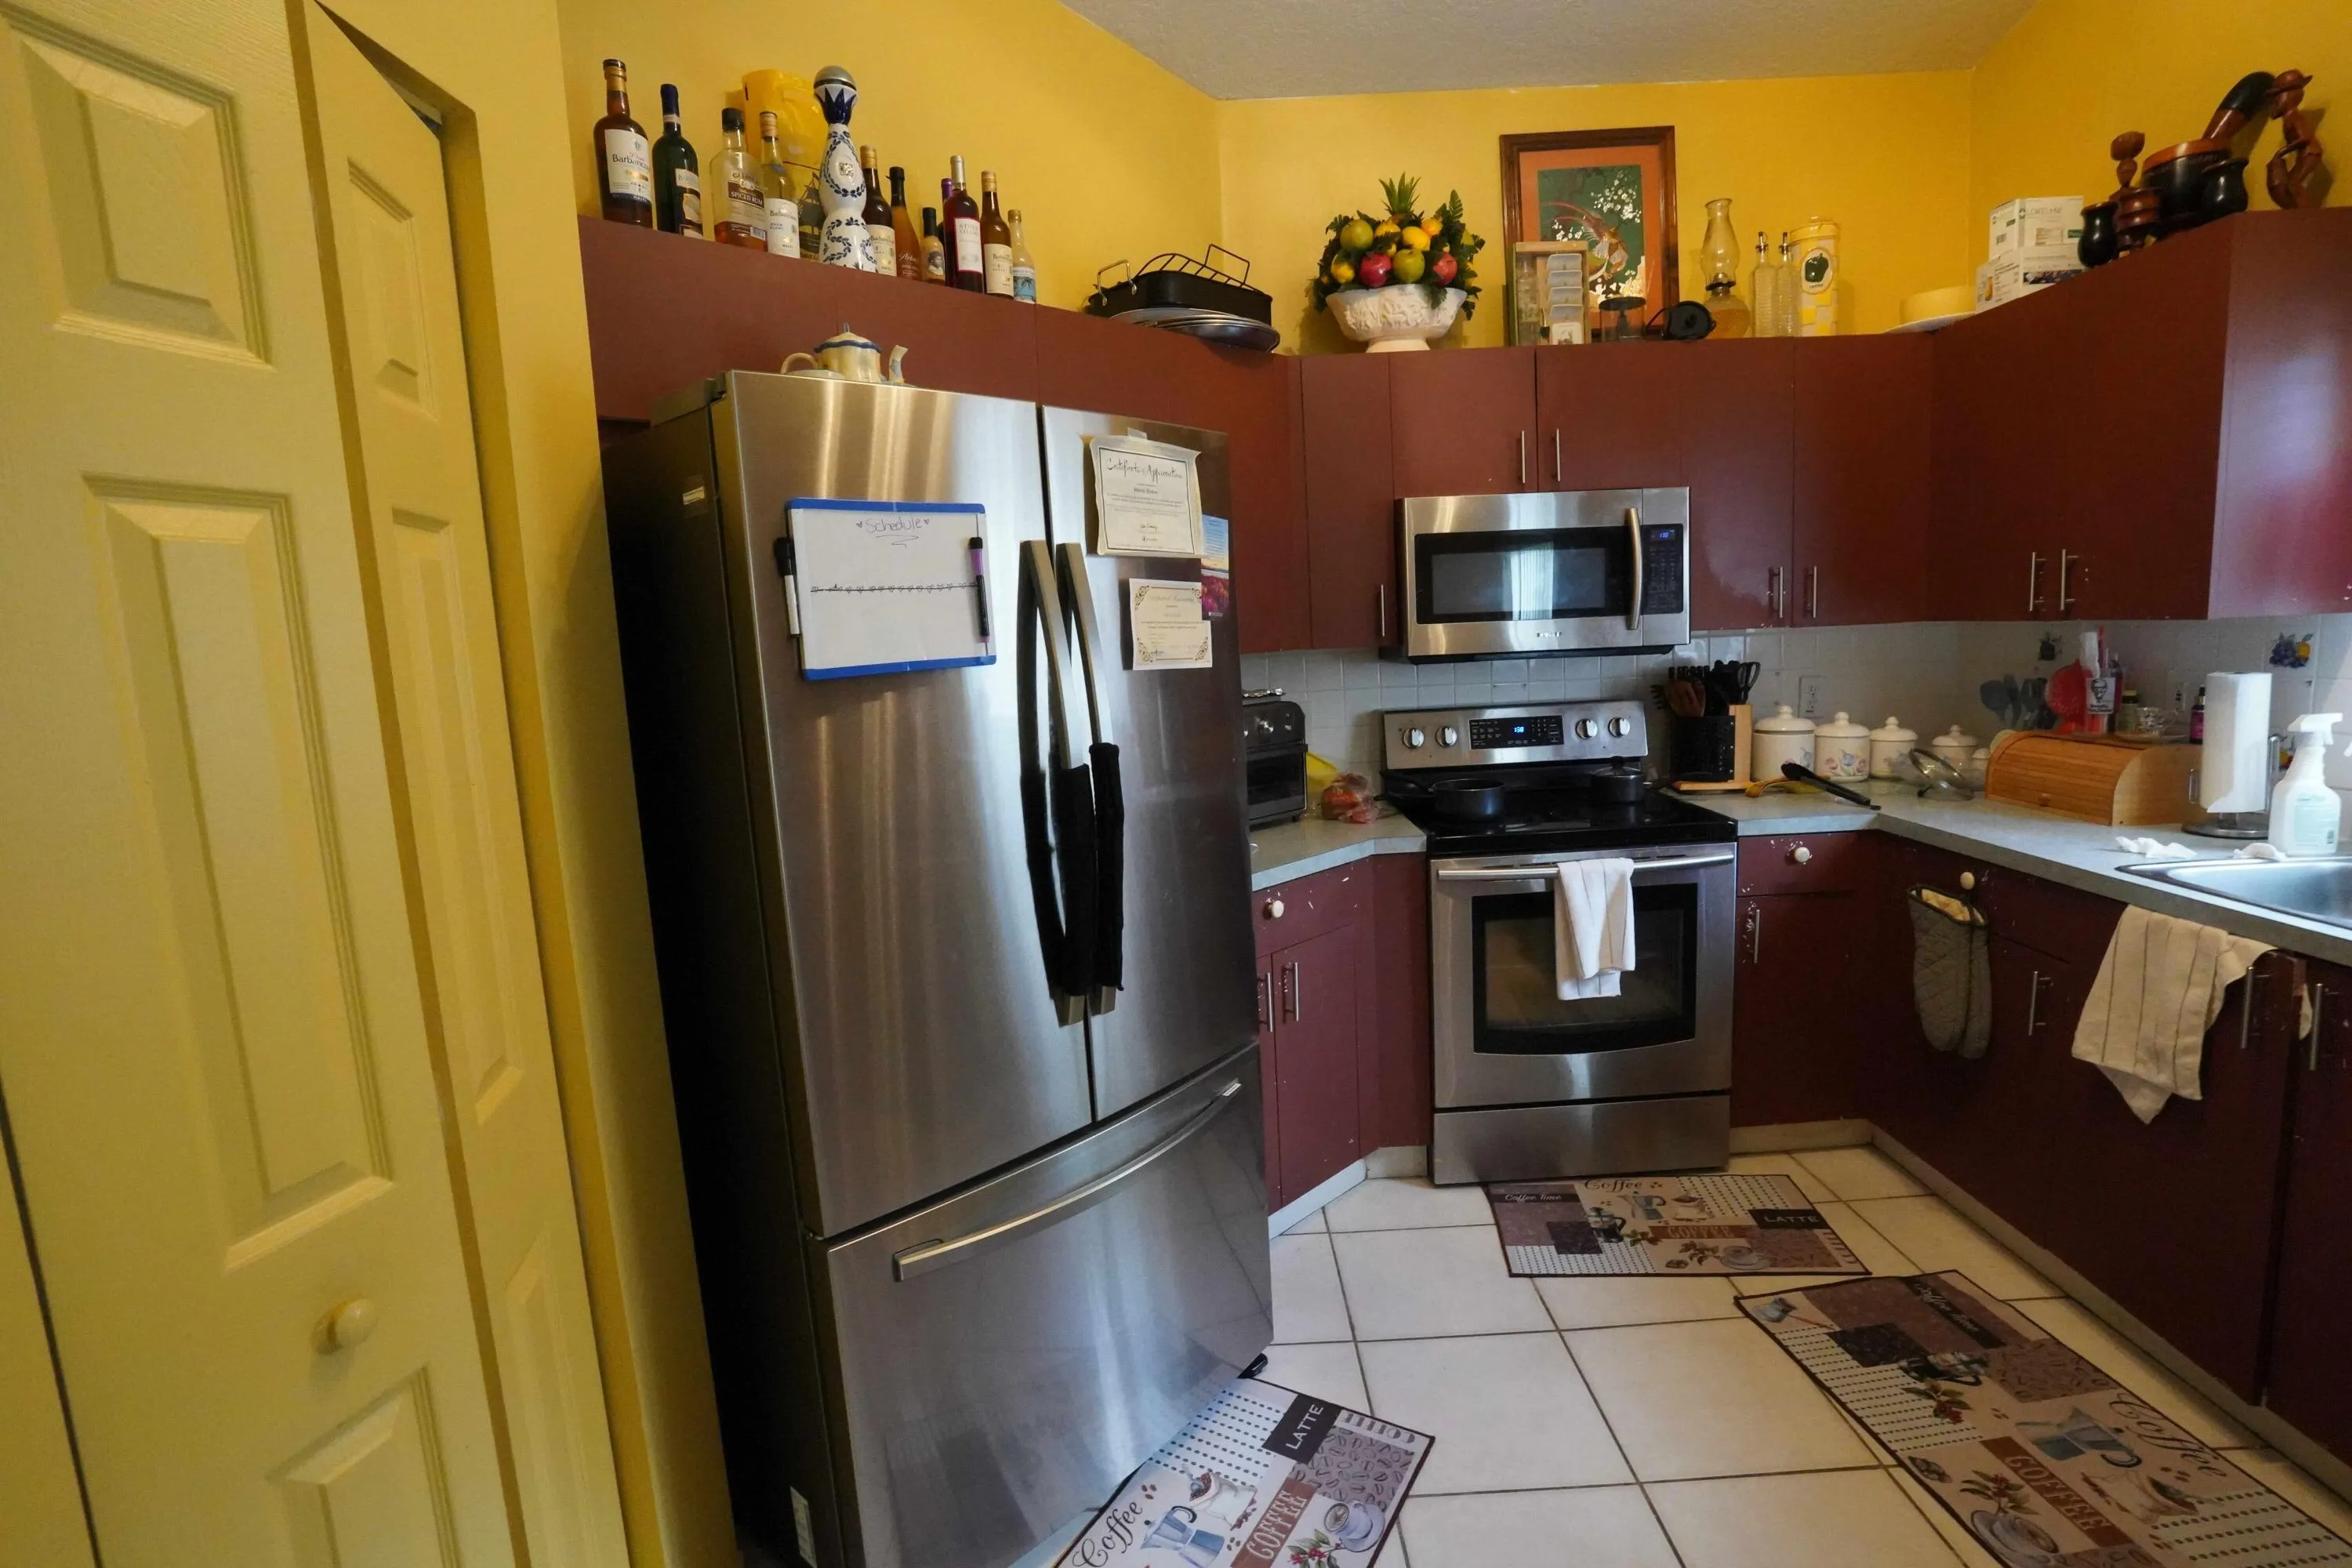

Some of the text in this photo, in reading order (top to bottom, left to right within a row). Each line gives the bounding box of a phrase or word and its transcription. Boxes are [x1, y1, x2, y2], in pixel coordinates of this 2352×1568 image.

[731, 191, 750, 201] SPICED
[865, 517, 923, 533] Schedule
[1504, 1192, 1537, 1203] Coffee
[1584, 1178, 1643, 1193] Coffee
[1668, 1225, 1736, 1239] COFFEE
[1285, 1403, 1324, 1450] LATTE
[2109, 1392, 2227, 1477] Coffee
[2008, 1456, 2110, 1530] COFFEE
[1072, 1501, 1143, 1568] Coffee
[1246, 1489, 1308, 1561] COFFEE
